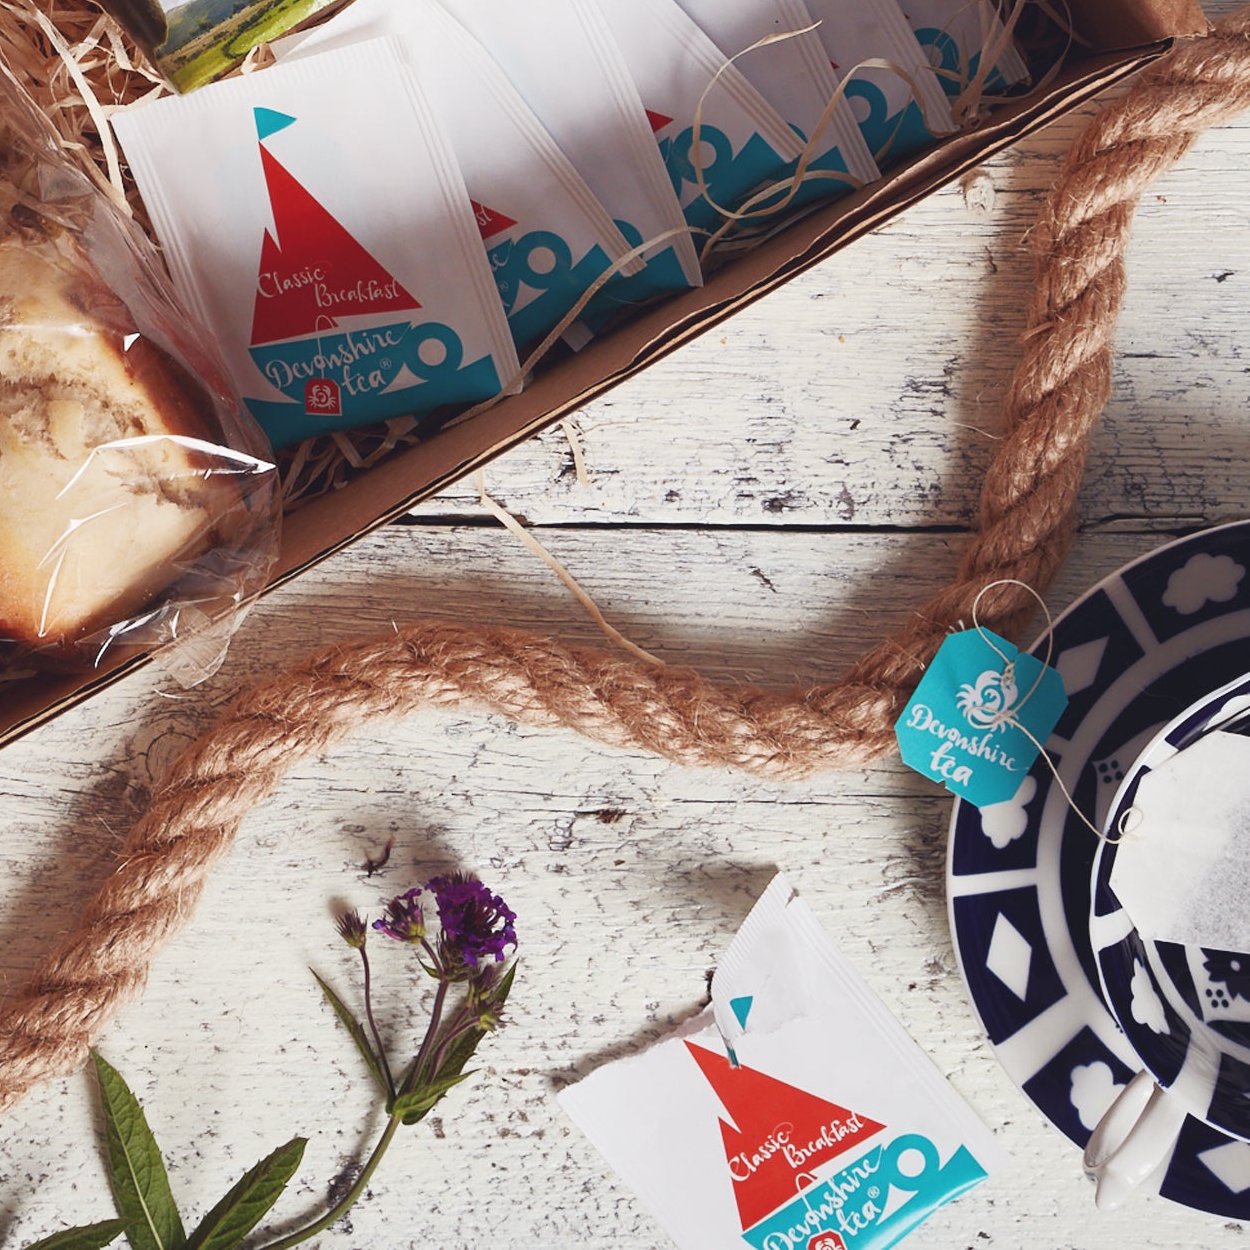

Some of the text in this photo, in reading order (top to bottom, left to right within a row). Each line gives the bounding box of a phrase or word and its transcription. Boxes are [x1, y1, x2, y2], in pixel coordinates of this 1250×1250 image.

[257, 266, 324, 298] Classic
[315, 279, 400, 308] Breakfast
[265, 330, 404, 389] Devonshire
[906, 703, 1014, 771] Devonshire
[930, 740, 974, 786] tea
[728, 1132, 791, 1181] Classic
[782, 1108, 864, 1169] Breakfast
[762, 1149, 882, 1250] Devonshire
